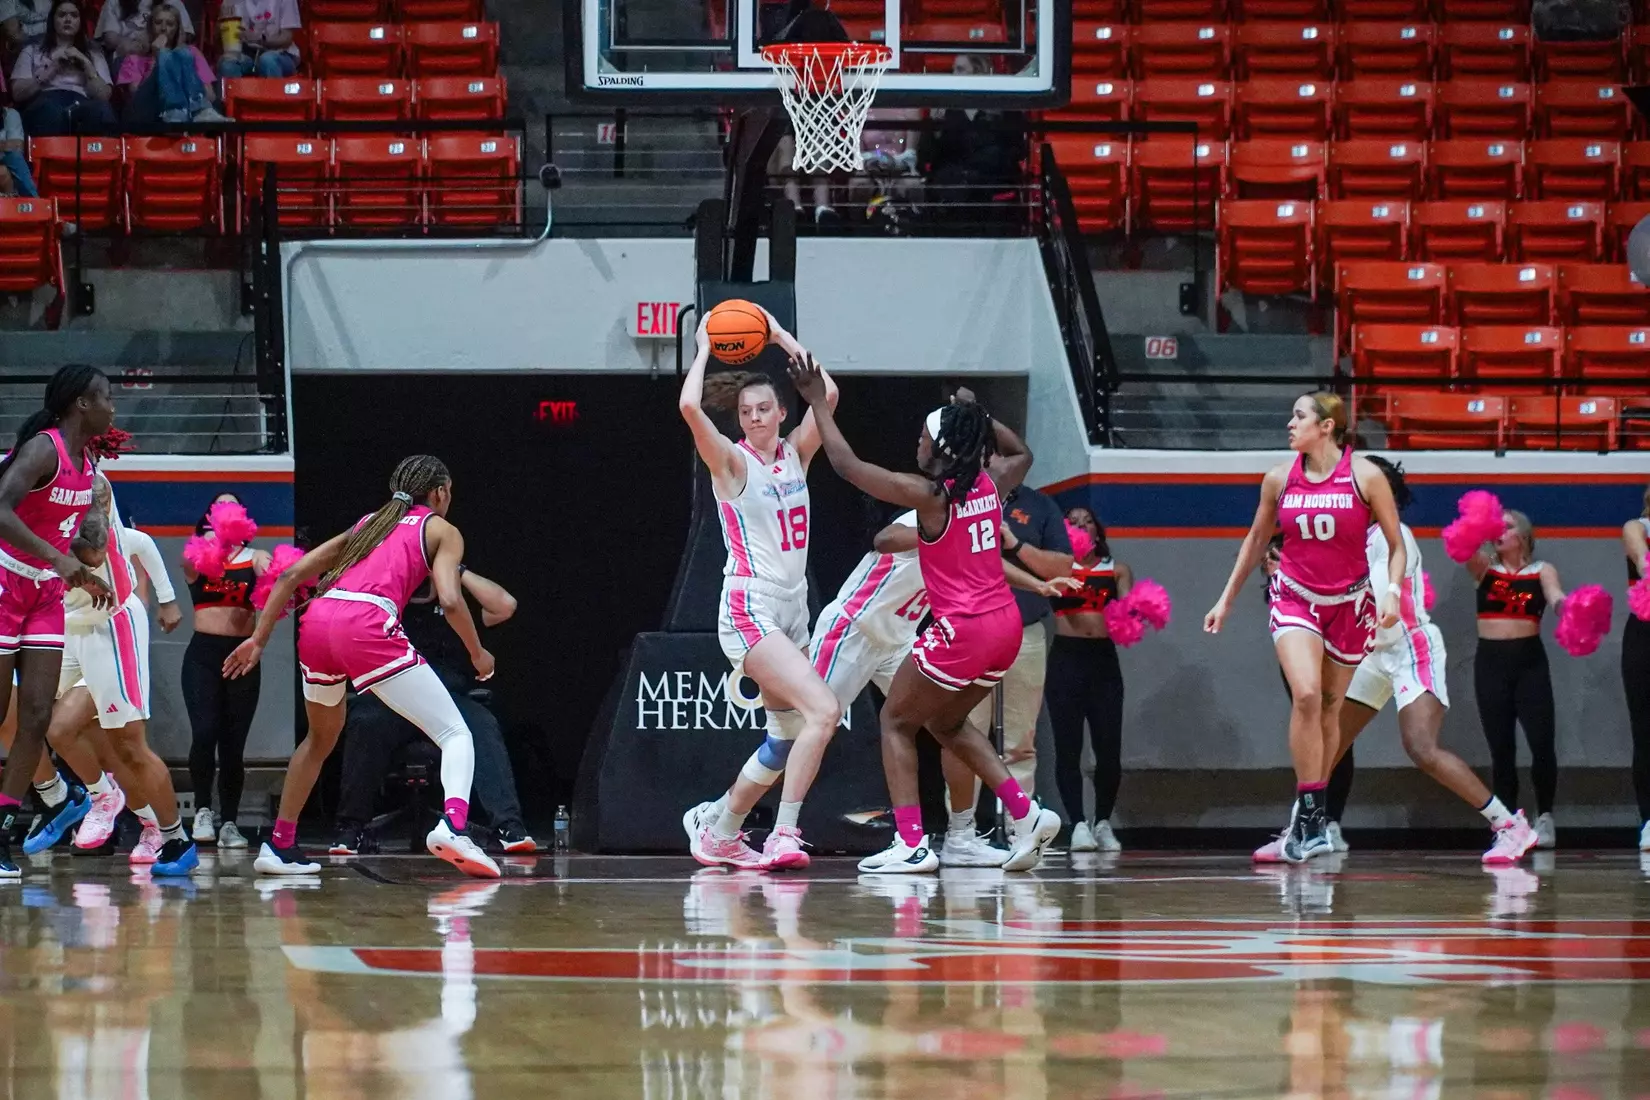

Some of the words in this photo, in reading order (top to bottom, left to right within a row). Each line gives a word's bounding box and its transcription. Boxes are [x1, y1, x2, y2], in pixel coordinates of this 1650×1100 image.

[598, 76, 644, 86] SPALDING
[637, 302, 680, 335] EXIT
[714, 340, 745, 353] NCAA
[1146, 339, 1178, 357] 06
[49, 486, 75, 505] SAM
[1282, 494, 1303, 508] SAM
[1303, 494, 1354, 508] HOUSTON
[58, 512, 80, 538] 4
[777, 505, 808, 551] 18
[968, 519, 996, 553] 12
[1295, 513, 1336, 541] 10
